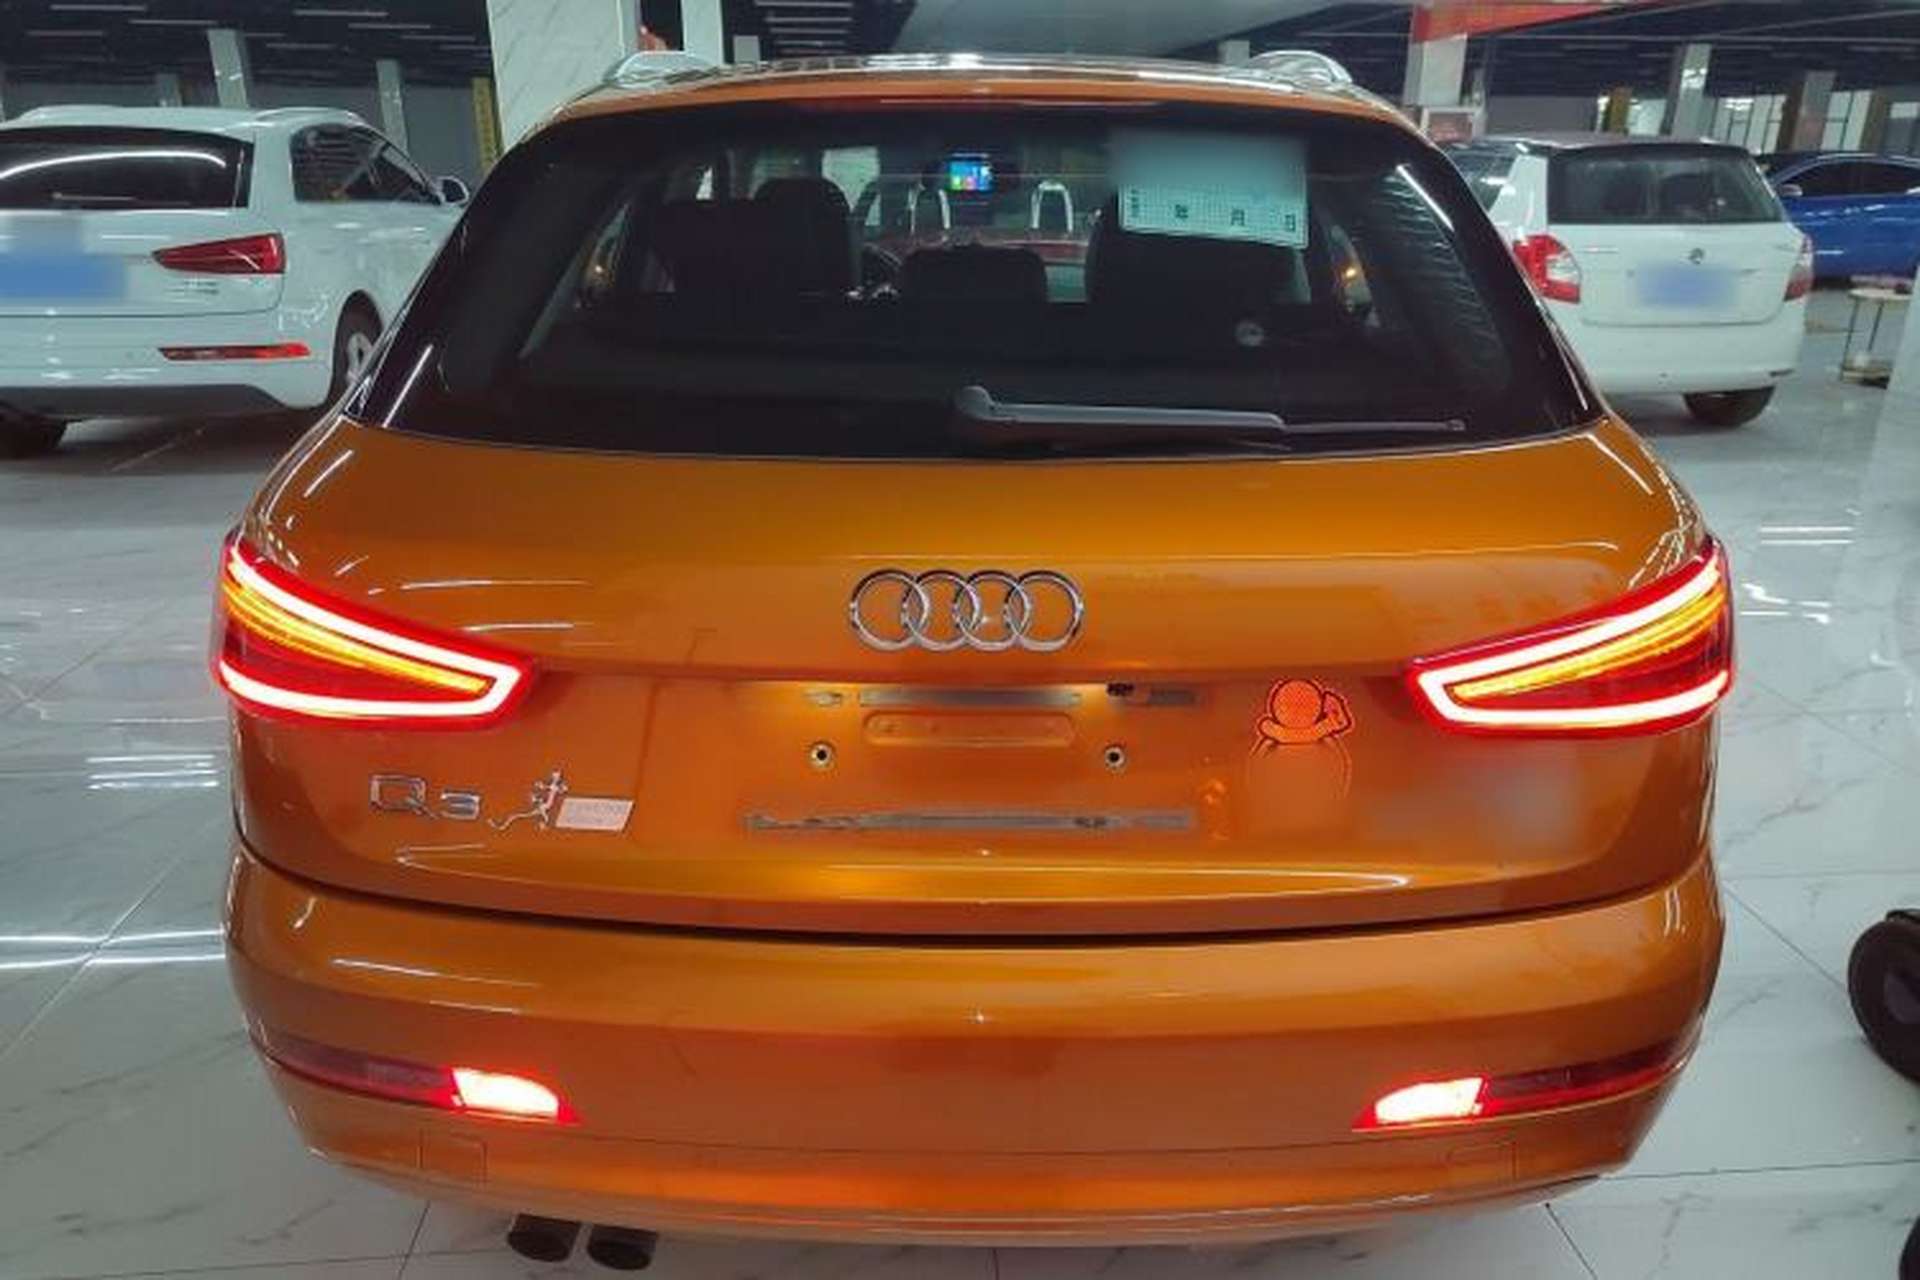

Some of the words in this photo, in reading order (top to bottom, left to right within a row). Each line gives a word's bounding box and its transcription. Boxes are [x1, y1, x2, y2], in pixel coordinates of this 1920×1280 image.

[1231, 208, 1245, 226] 月
[1285, 212, 1297, 232] 日
[368, 774, 481, 820] Q3
